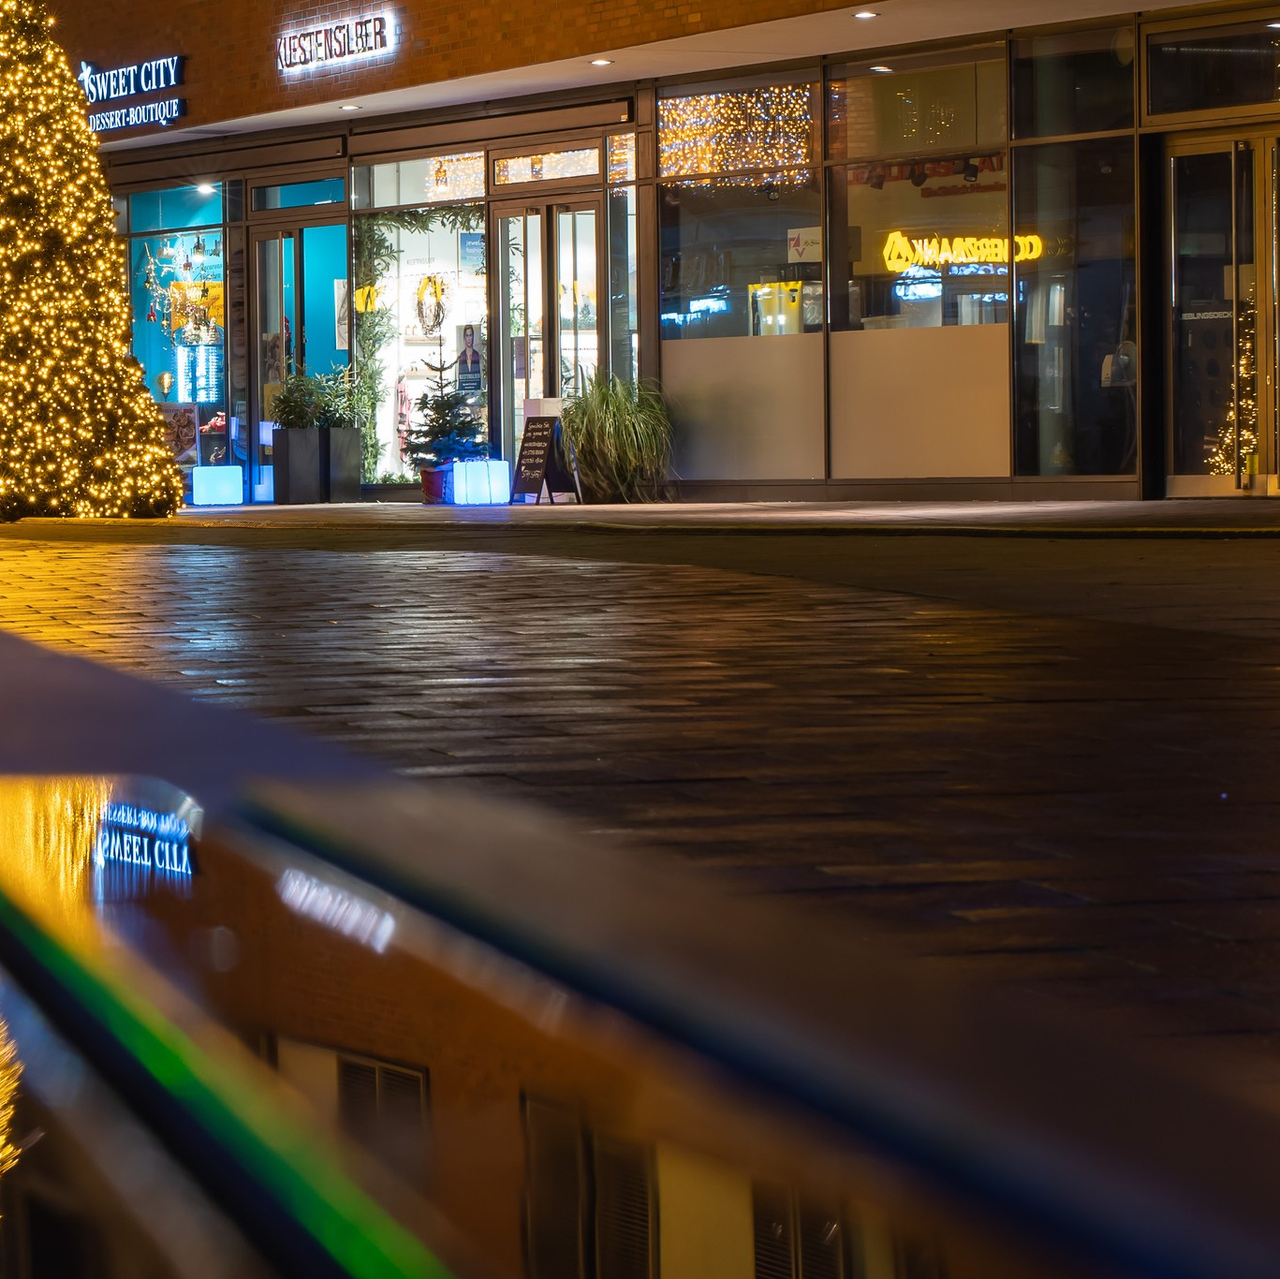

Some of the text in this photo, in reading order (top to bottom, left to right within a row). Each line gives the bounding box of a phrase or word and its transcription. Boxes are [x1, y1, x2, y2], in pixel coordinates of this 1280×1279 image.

[89, 56, 178, 102] SWEET CITY
[89, 99, 179, 132] DESSERT-BOUTIQUE
